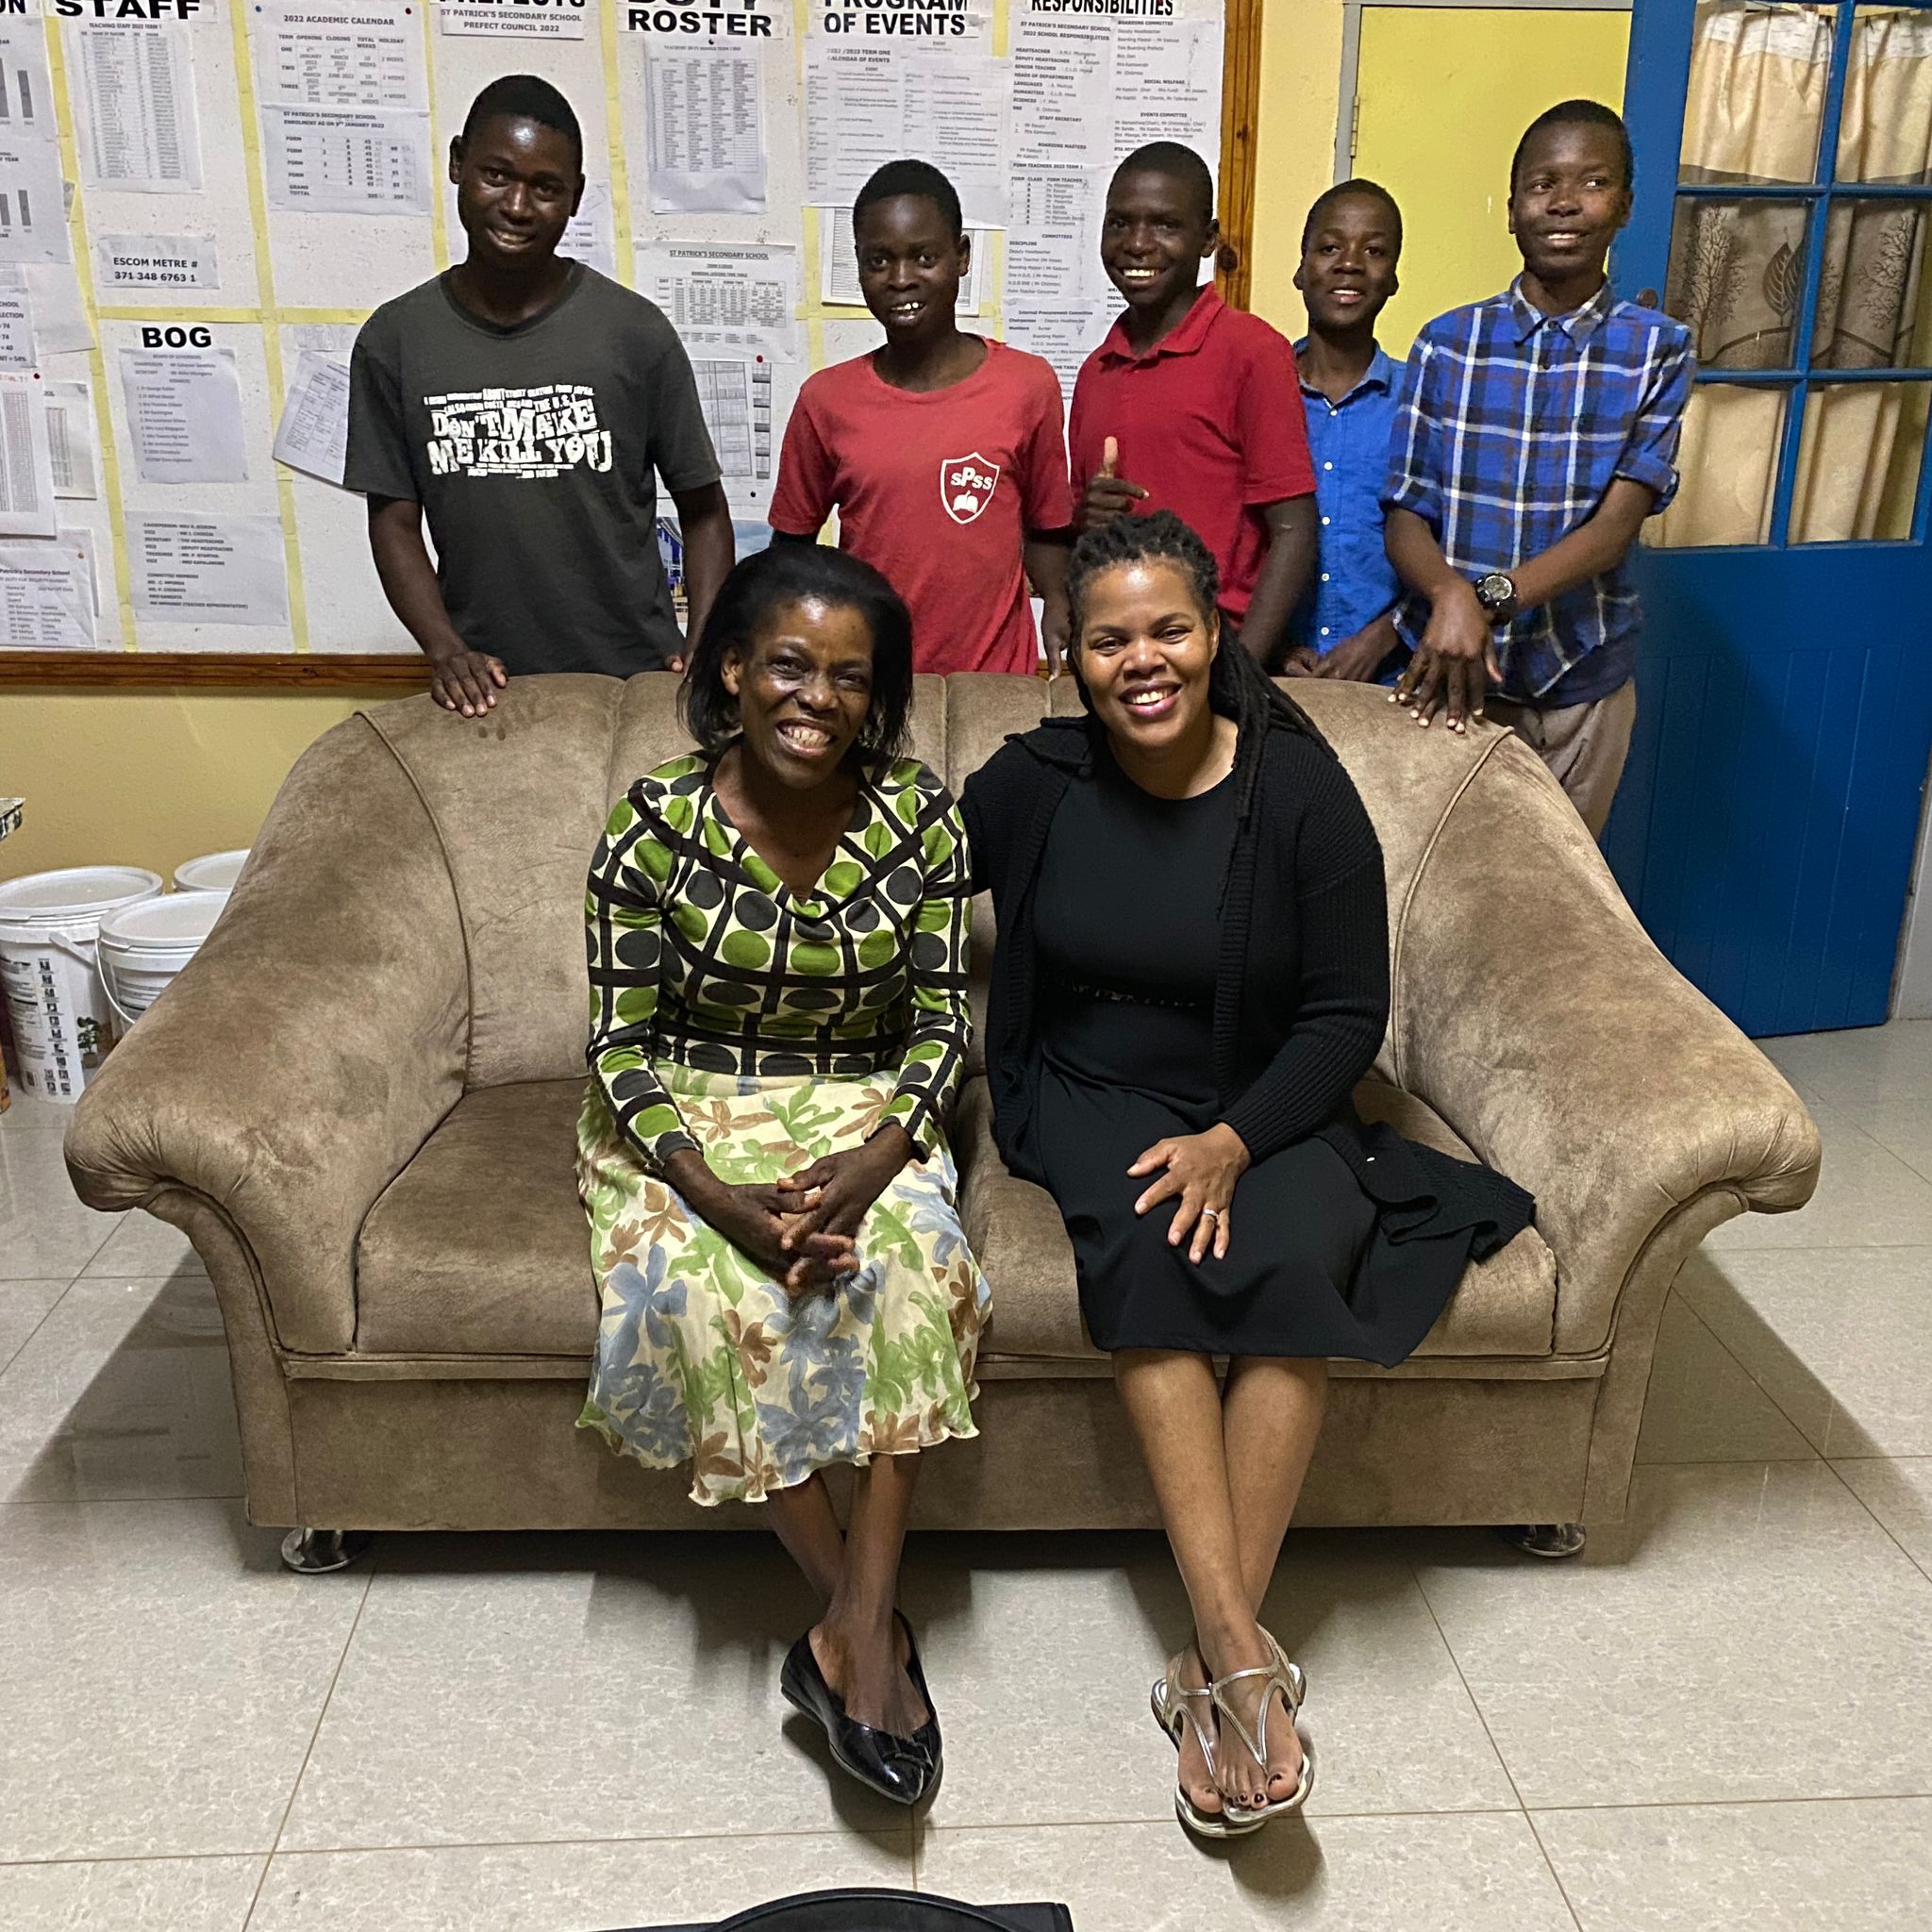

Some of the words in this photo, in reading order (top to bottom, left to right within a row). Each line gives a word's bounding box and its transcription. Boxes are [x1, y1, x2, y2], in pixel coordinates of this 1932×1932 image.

[56, 0, 200, 20] STAFF
[1031, 0, 1173, 16] RESPONSIBILITIES
[306, 15, 349, 24] ACADEMIC
[351, 17, 394, 25] CALENDAR
[454, 9, 496, 18] PATRICK'S
[498, 11, 547, 20] SECONDARY
[549, 13, 582, 22] SCHOOL
[628, 8, 772, 37] ROSTER
[463, 21, 499, 29] PREFECT
[501, 23, 537, 31] COUNCIL
[824, 12, 857, 33] OF
[866, 13, 965, 36] EVENTS
[1059, 32, 1109, 41] RESPONSIBILITIES
[113, 257, 149, 267] ESCOM
[153, 258, 188, 268] METRE
[115, 272, 133, 280] 371
[138, 273, 158, 281] 348
[160, 274, 186, 282] 6763
[142, 326, 212, 348] BOG
[544, 431, 612, 473] YOU
